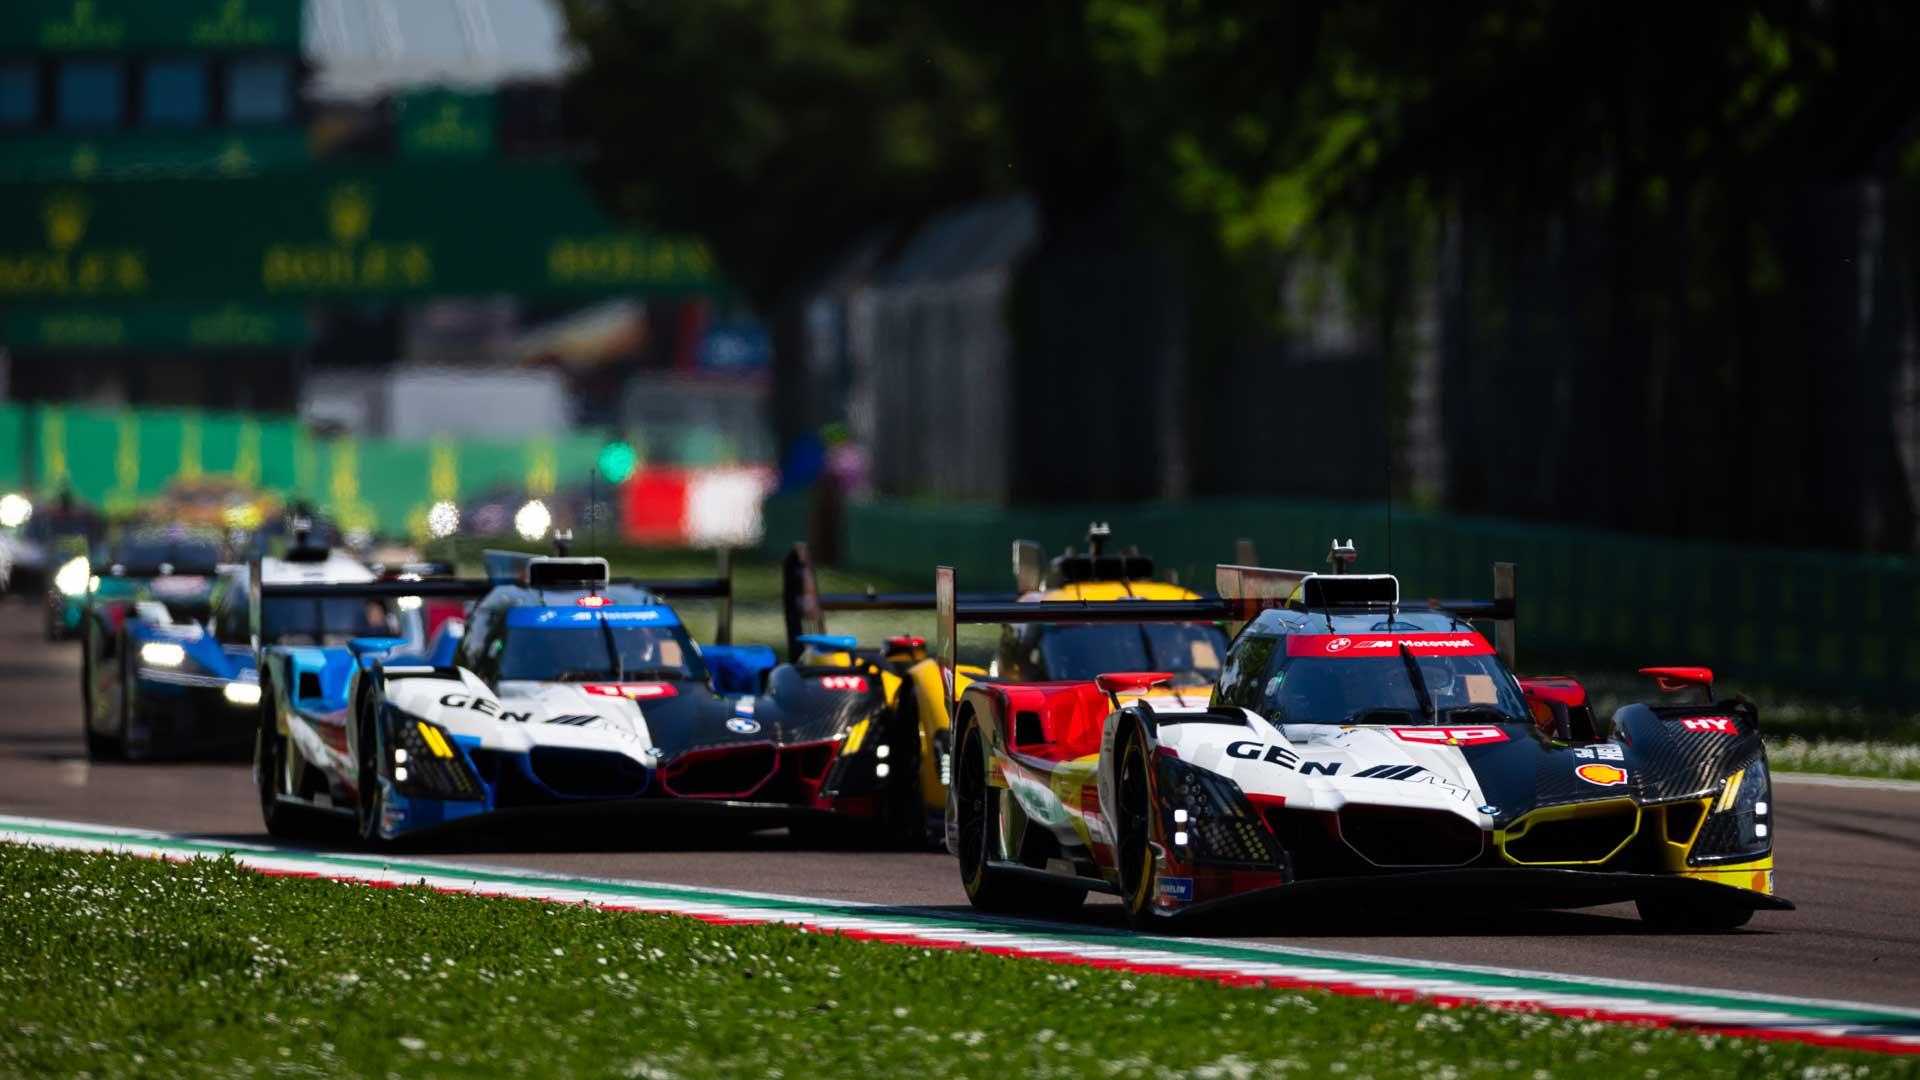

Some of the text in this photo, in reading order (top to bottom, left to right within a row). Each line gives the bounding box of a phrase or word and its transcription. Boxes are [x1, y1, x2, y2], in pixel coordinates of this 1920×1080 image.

[1397, 639, 1475, 648] Motorsport
[440, 693, 533, 722] GEN
[1683, 718, 1728, 730] HY
[1226, 740, 1342, 776] GEN
